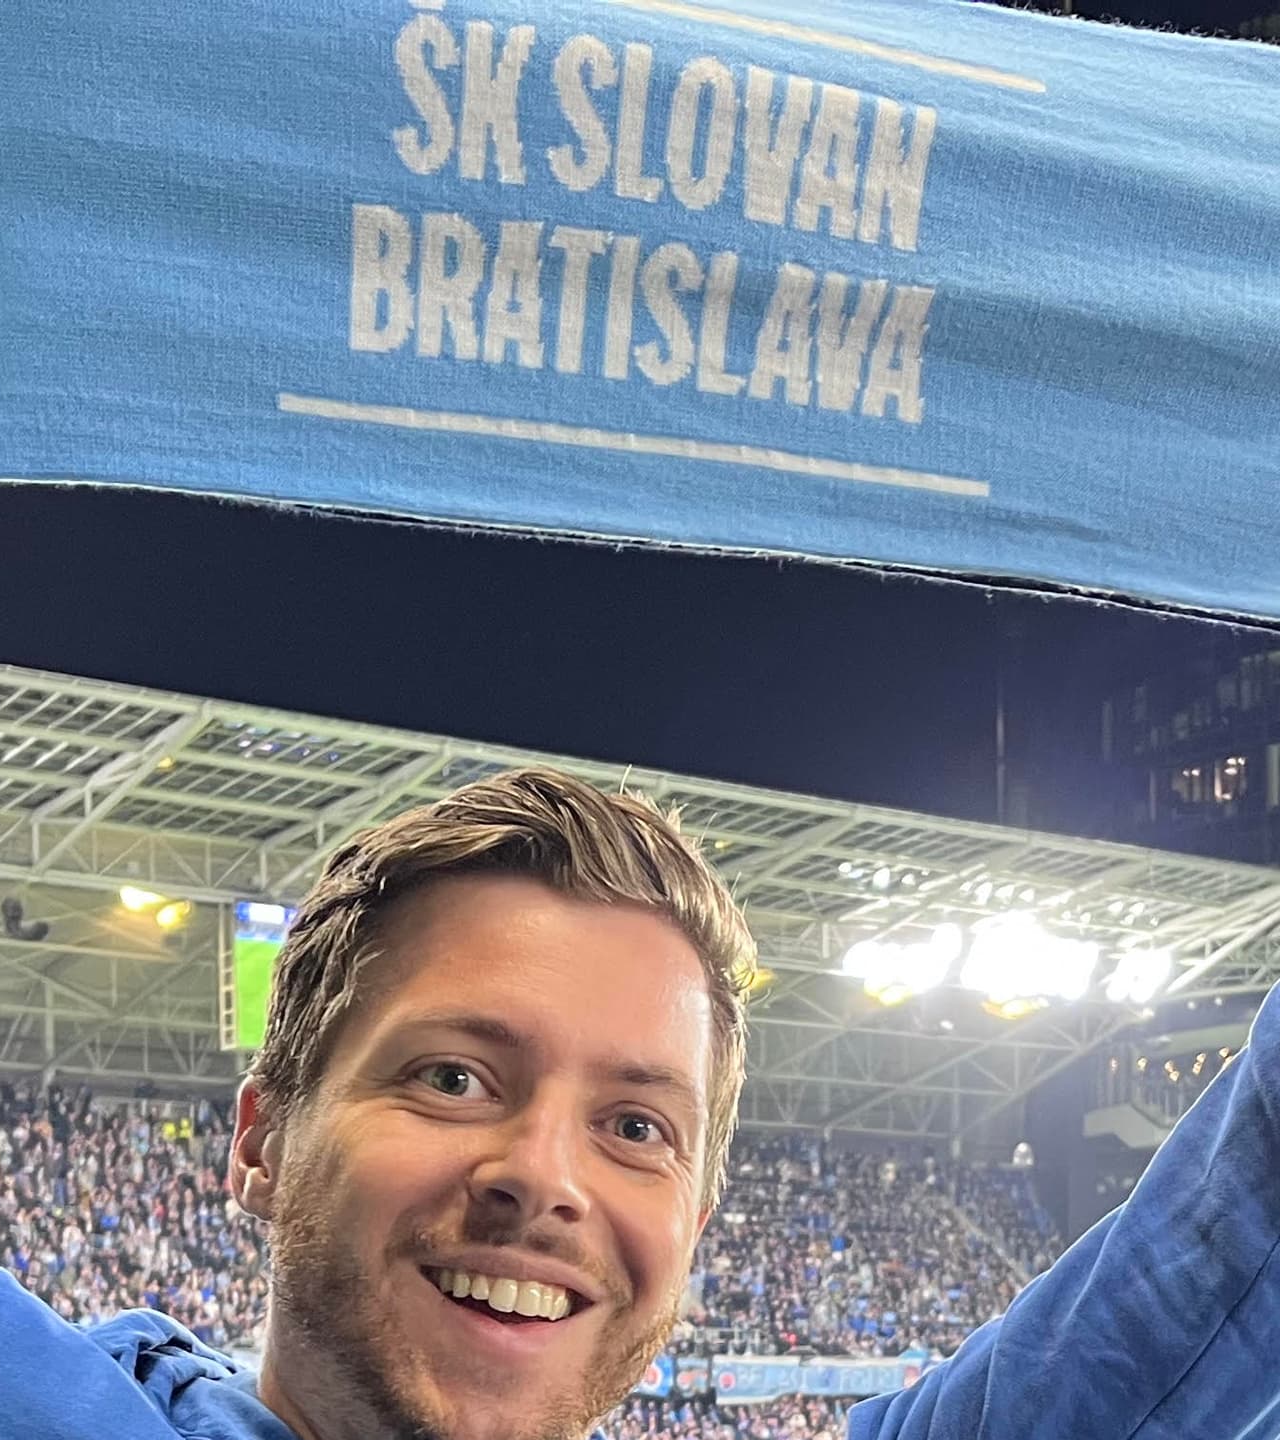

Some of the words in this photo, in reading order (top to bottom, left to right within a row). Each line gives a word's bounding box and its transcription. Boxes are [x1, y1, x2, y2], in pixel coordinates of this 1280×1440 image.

[392, 0, 536, 185] ŠK
[548, 34, 938, 252] SLOVAN
[350, 204, 937, 425] BRATISLAVA
